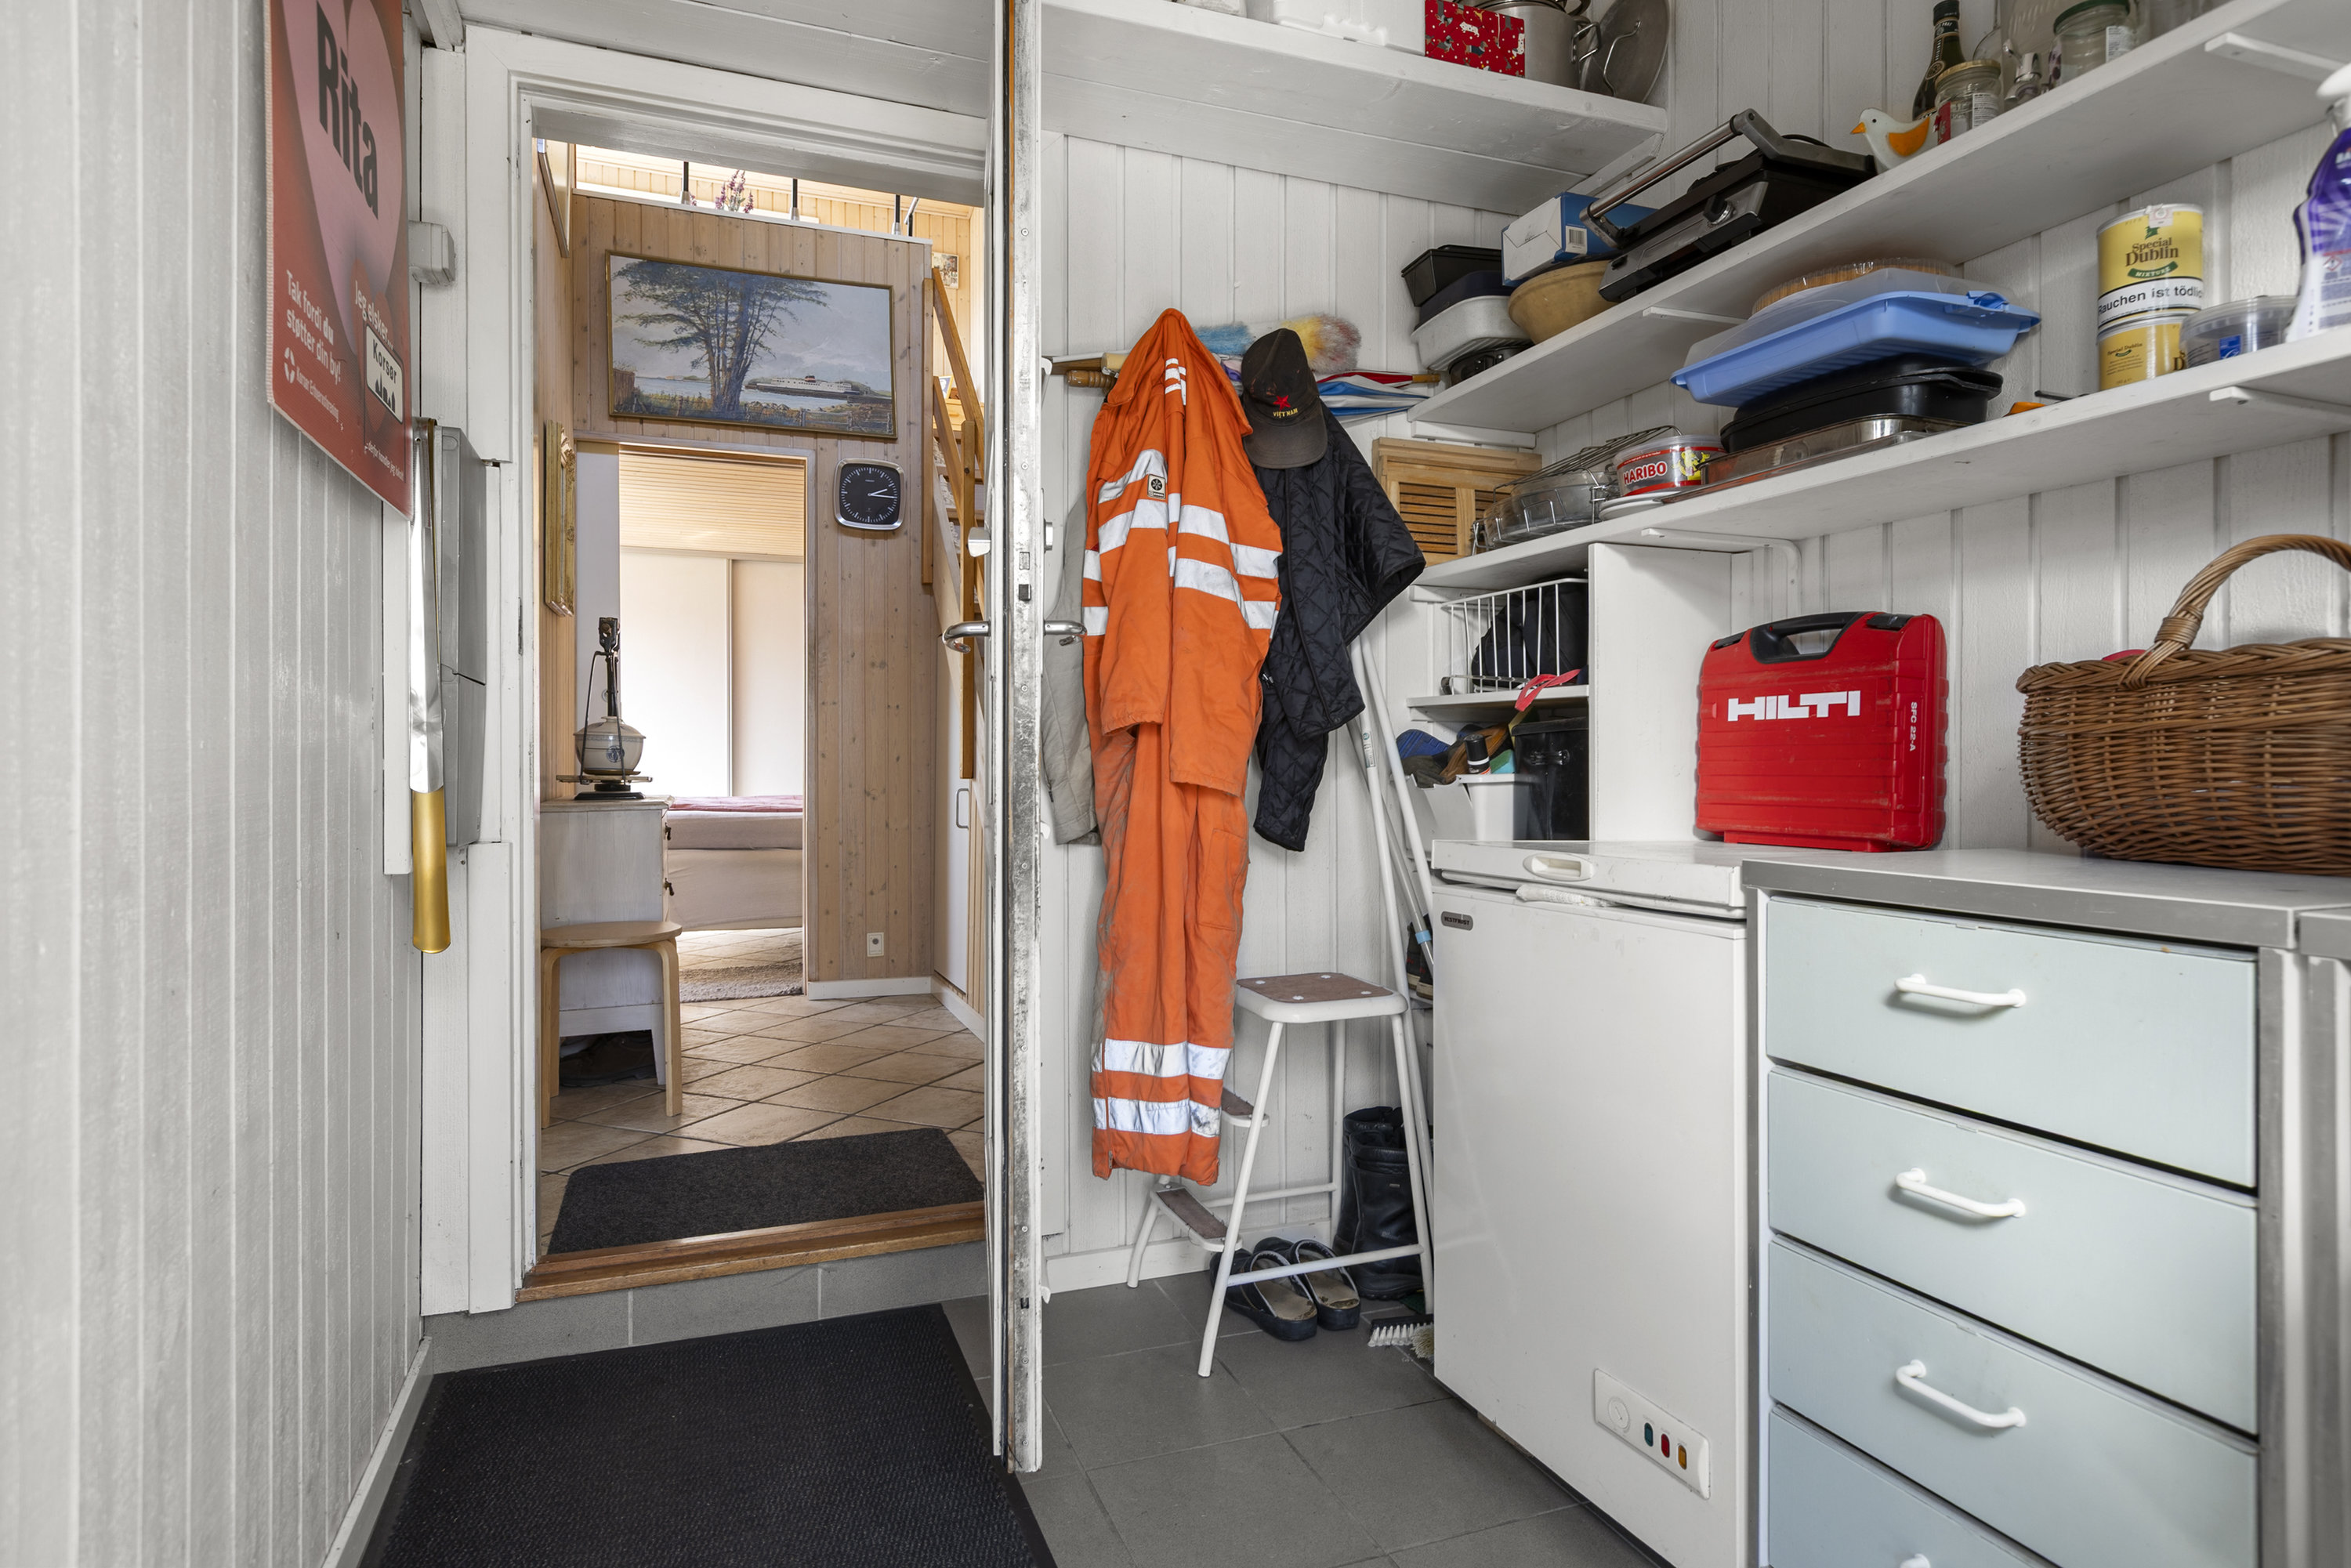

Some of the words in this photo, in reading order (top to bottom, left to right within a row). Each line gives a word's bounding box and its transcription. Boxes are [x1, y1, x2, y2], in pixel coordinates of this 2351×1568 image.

[317, 2, 379, 220] Rita
[2125, 247, 2179, 267] Dublin
[2132, 237, 2172, 253] Special
[286, 269, 302, 308] Tak
[303, 290, 322, 331] fordi
[323, 316, 334, 346] du
[355, 280, 367, 321] Jeg
[2151, 288, 2170, 299] ist
[286, 309, 315, 353] støtter
[317, 339, 328, 369] din
[330, 351, 341, 386] by!
[372, 339, 397, 385] Korsør
[1623, 461, 1668, 485] HARIBO
[1727, 690, 1861, 722] HILTI
